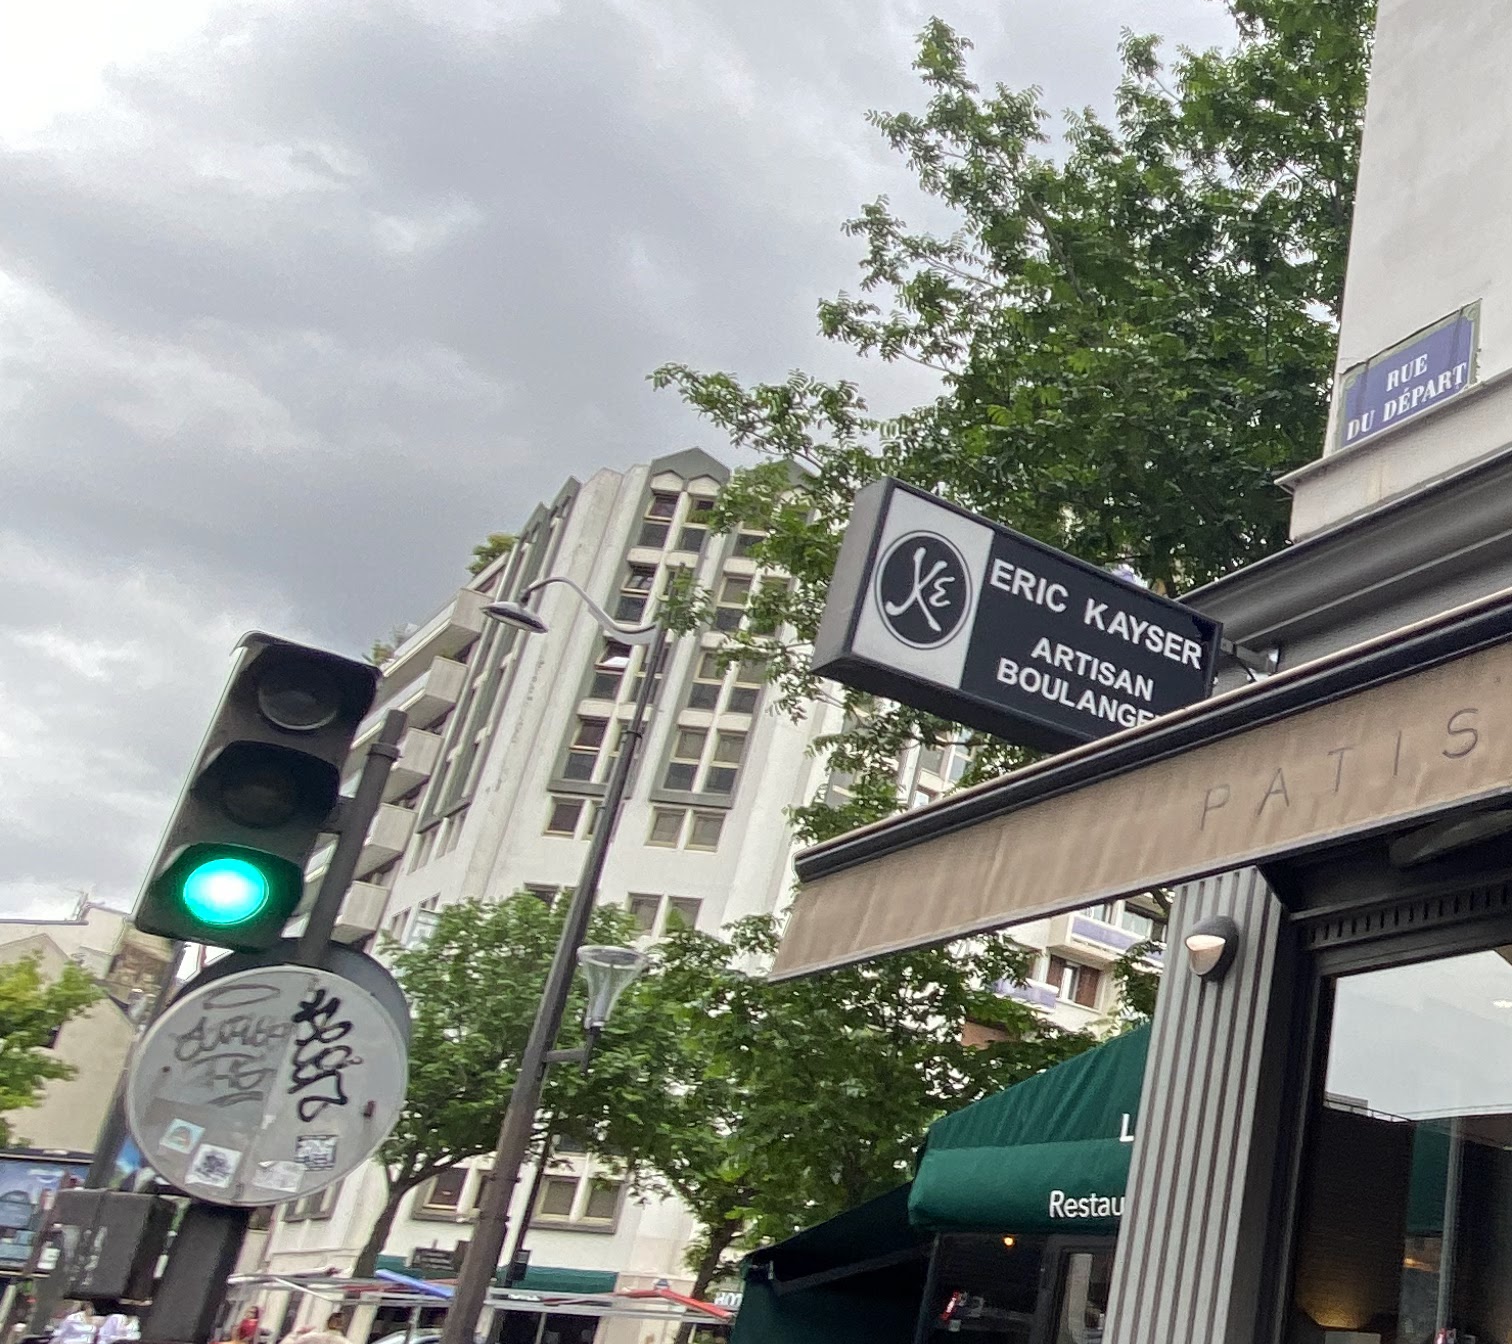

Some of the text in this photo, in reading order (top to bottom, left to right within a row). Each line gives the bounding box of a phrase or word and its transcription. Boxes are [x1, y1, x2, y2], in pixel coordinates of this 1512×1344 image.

[1346, 362, 1467, 441] DU DÉPART
[1385, 353, 1428, 392] RUE
[989, 557, 1202, 670] ERIC KAYSER
[996, 657, 1163, 729] BOULANGE
[1030, 636, 1154, 702] ARTISAN
